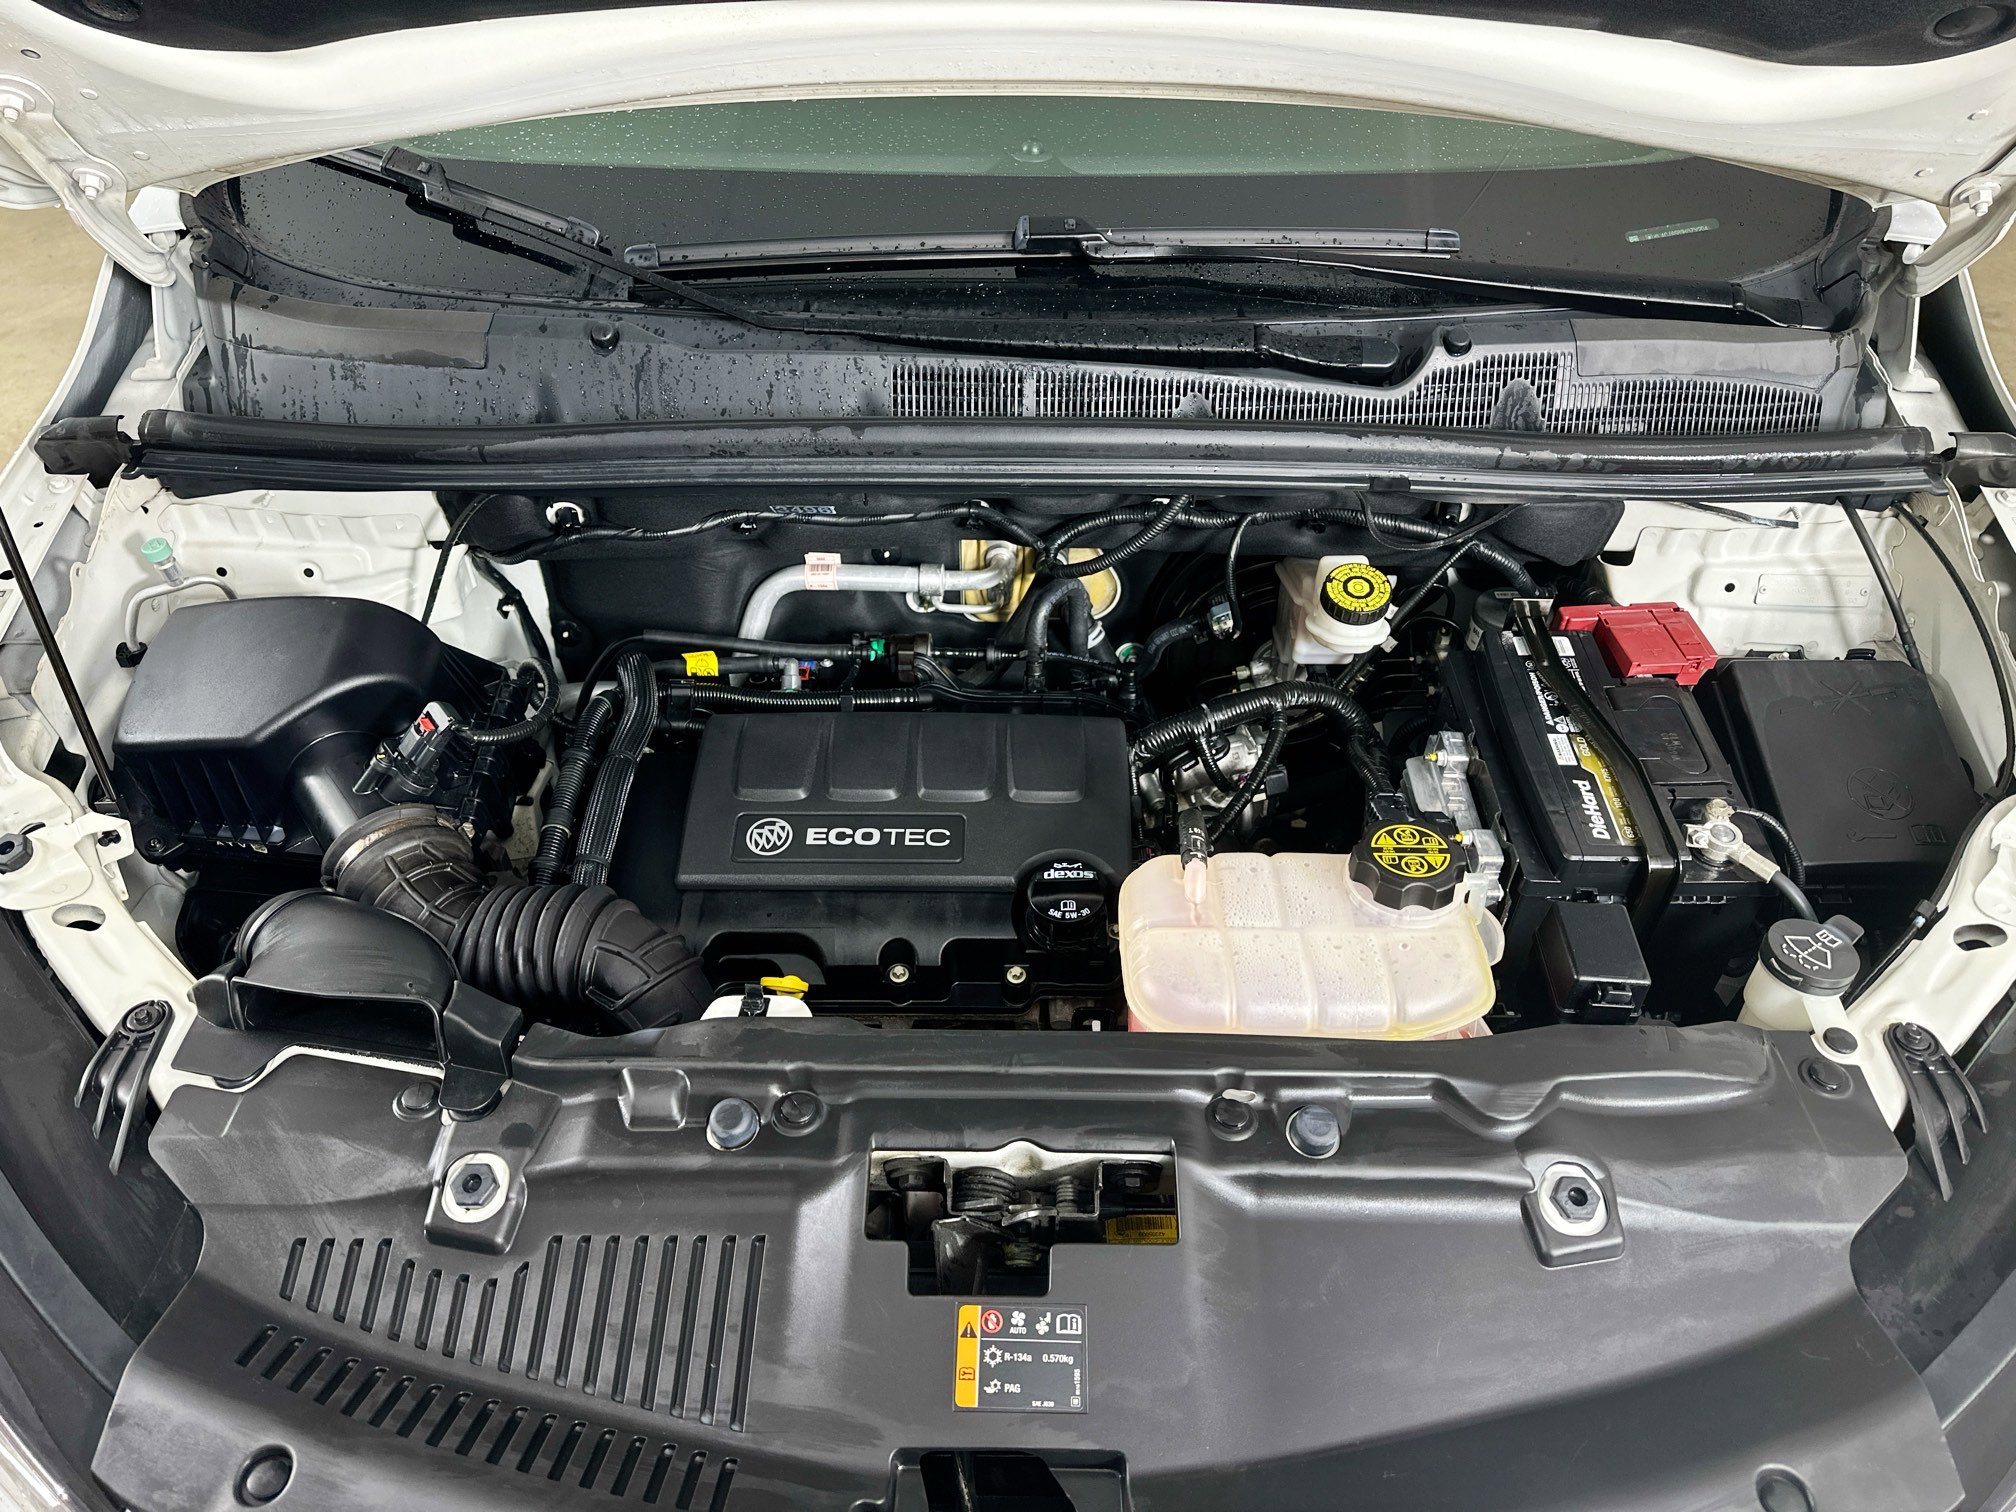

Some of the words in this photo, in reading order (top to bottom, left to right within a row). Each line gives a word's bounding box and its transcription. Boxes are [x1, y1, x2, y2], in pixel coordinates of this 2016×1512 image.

[1577, 737, 1591, 757] GOLD
[1573, 779, 1611, 840] DieHard
[805, 827, 951, 847] ECOTEC
[1043, 868, 1094, 880] dexos
[1048, 908, 1063, 919] SAE
[1065, 907, 1091, 919] 5W-30
[1009, 1326, 1027, 1335] AUTO
[1004, 1353, 1033, 1362] R-134a
[1042, 1353, 1074, 1365] 0.570kg
[1004, 1383, 1021, 1394] PAG
